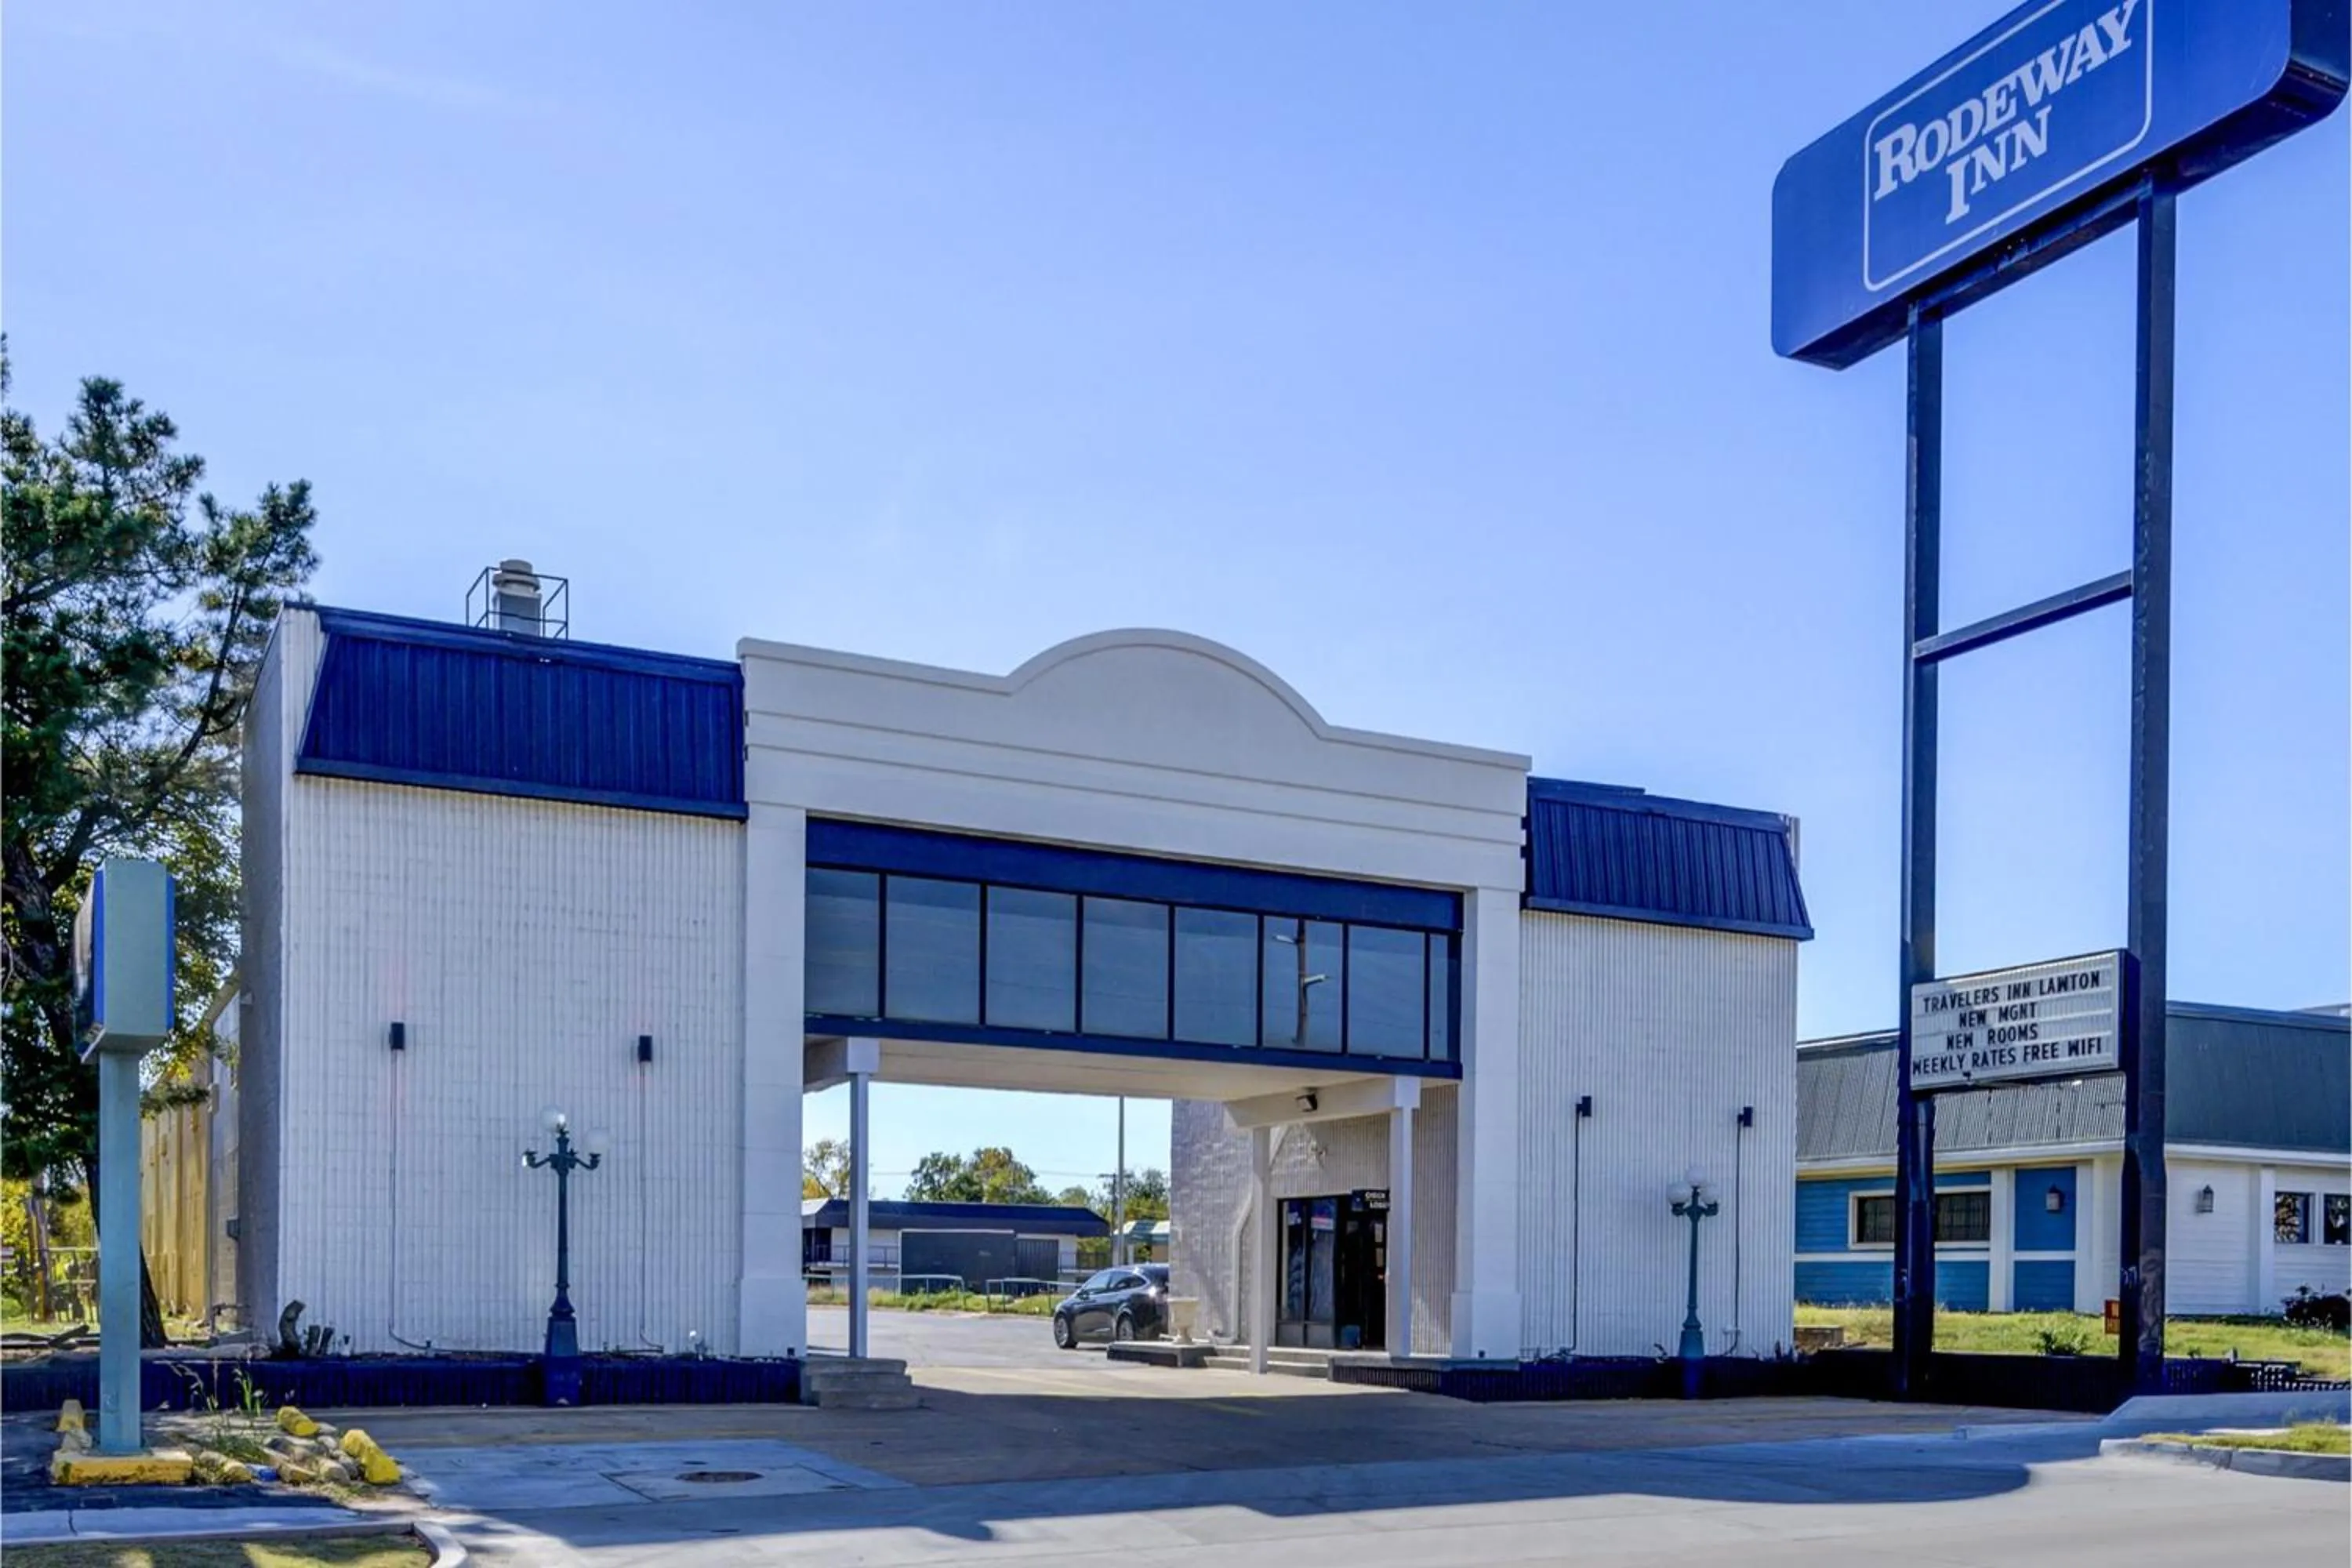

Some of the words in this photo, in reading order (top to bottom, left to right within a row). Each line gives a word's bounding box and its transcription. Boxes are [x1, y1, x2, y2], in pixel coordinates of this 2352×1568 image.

[1874, 0, 2139, 201] RODEWAY
[1945, 107, 2052, 225] INN
[1924, 987, 1998, 1012] TRAVELERS
[2007, 982, 2031, 1000] INN
[2039, 970, 2100, 996] LAWTON
[1947, 1033, 1973, 1051] NEW
[1987, 1023, 2038, 1045] ROOMS
[1959, 1009, 1987, 1027] NEW
[1913, 1053, 1965, 1075] WEEKLY
[1972, 1047, 2016, 1067] RATES
[2024, 1041, 2059, 1062] FREE
[2067, 1037, 2101, 1057] WIFI
